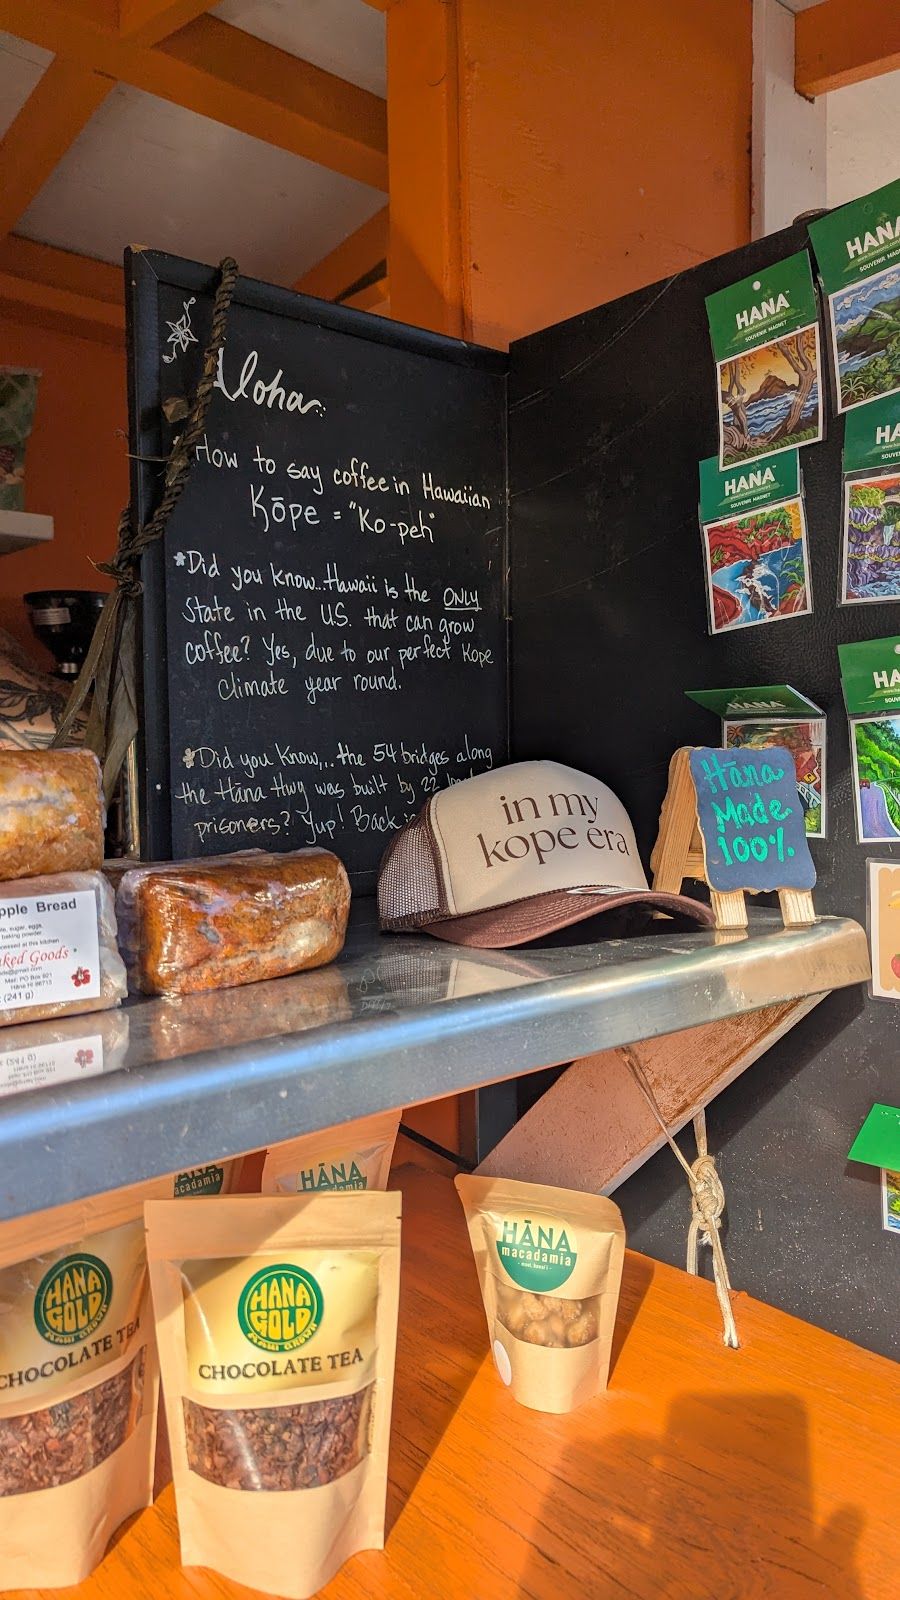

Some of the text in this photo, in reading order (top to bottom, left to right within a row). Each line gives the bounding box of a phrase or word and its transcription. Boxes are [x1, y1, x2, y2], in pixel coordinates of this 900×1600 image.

[887, 249, 900, 260] MAG
[195, 434, 491, 510] How to say coffee in Hawaiian
[250, 484, 320, 532] Kōpe
[186, 551, 220, 578] Did
[231, 566, 263, 591] you
[323, 563, 377, 593] Hawaii
[384, 578, 399, 599] is
[404, 572, 431, 603] the
[444, 587, 482, 611] ONLY
[246, 602, 266, 621] in
[275, 598, 307, 621] the
[364, 606, 399, 629] that
[406, 615, 433, 632] can
[439, 618, 475, 644] grow
[185, 630, 250, 665] coffee?
[262, 632, 297, 668] Yes,
[305, 632, 335, 663] due
[340, 639, 356, 662] to
[367, 646, 390, 663] our
[399, 634, 452, 670] perfect
[305, 676, 342, 704] year
[353, 666, 402, 691] round.
[194, 746, 234, 769] Did
[240, 752, 274, 778] you
[336, 742, 366, 766] the
[372, 743, 397, 763] 54
[400, 742, 450, 776] bridges
[456, 733, 493, 769] along
[701, 753, 785, 793] Hāna
[174, 782, 211, 805] the
[214, 776, 268, 803] Hāna
[270, 772, 310, 815] Hwy
[314, 781, 345, 799] was
[350, 773, 388, 796] built
[397, 773, 415, 805] by
[421, 776, 440, 792] 22
[500, 793, 599, 825] in my
[711, 792, 793, 833] Made
[194, 810, 291, 843] prisoners?
[301, 803, 345, 845] Yup!
[350, 805, 402, 833] Back
[476, 827, 630, 868] kope era
[717, 827, 795, 866] 100%
[36, 898, 77, 913] Bread
[0, 945, 69, 968] ked Goods
[3, 991, 22, 1003] (241
[174, 1173, 221, 1195] acadamia
[502, 1219, 571, 1253] HĀNA
[501, 1246, 572, 1267] macadamia
[46, 1267, 102, 1309] HANA
[250, 1276, 311, 1310] HANA
[45, 1291, 102, 1333] GOLD
[250, 1307, 311, 1340] GOLD
[199, 1348, 364, 1380] CHOCOLATE TEA
